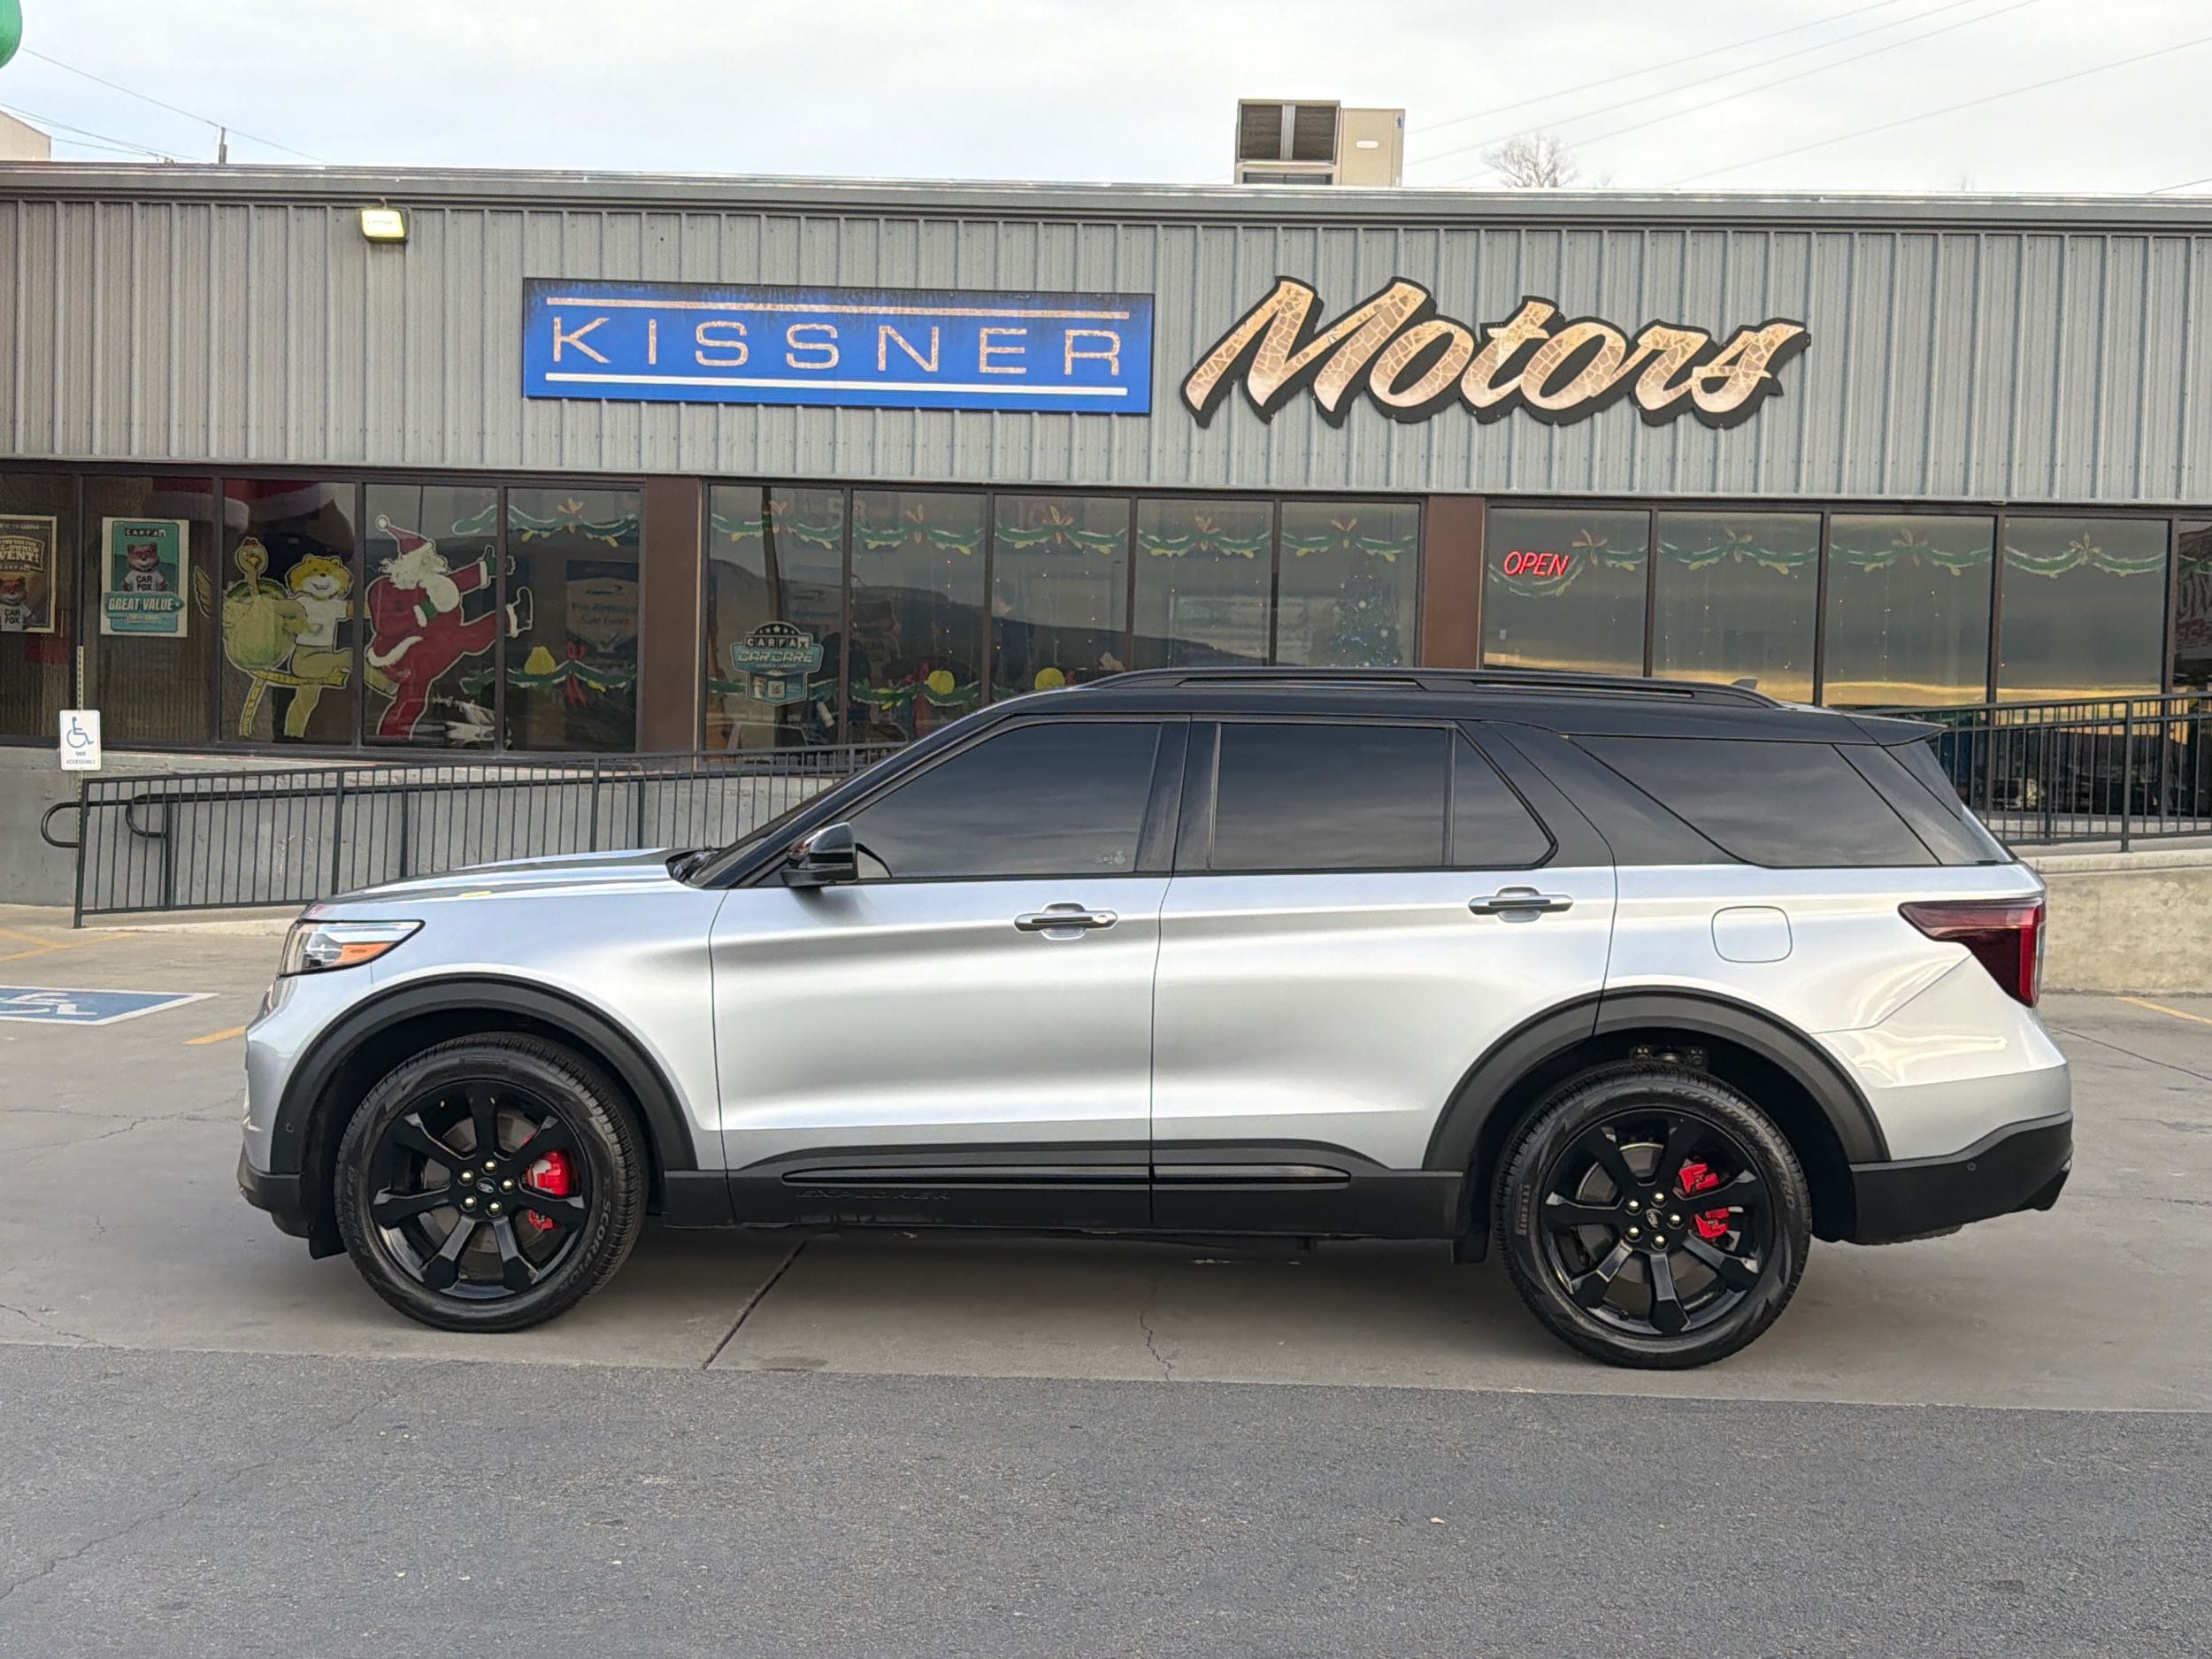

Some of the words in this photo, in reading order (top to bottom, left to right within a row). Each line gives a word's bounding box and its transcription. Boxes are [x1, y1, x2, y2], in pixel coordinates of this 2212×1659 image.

[553, 316, 1122, 376] KISSNER
[1183, 278, 1808, 419] Motors
[1504, 551, 1570, 576] OPEN
[108, 598, 140, 611] GREAT
[142, 598, 174, 611] VALUE
[746, 637, 809, 649] CARFAX
[738, 651, 771, 662] CAR
[772, 651, 813, 663] CARE
